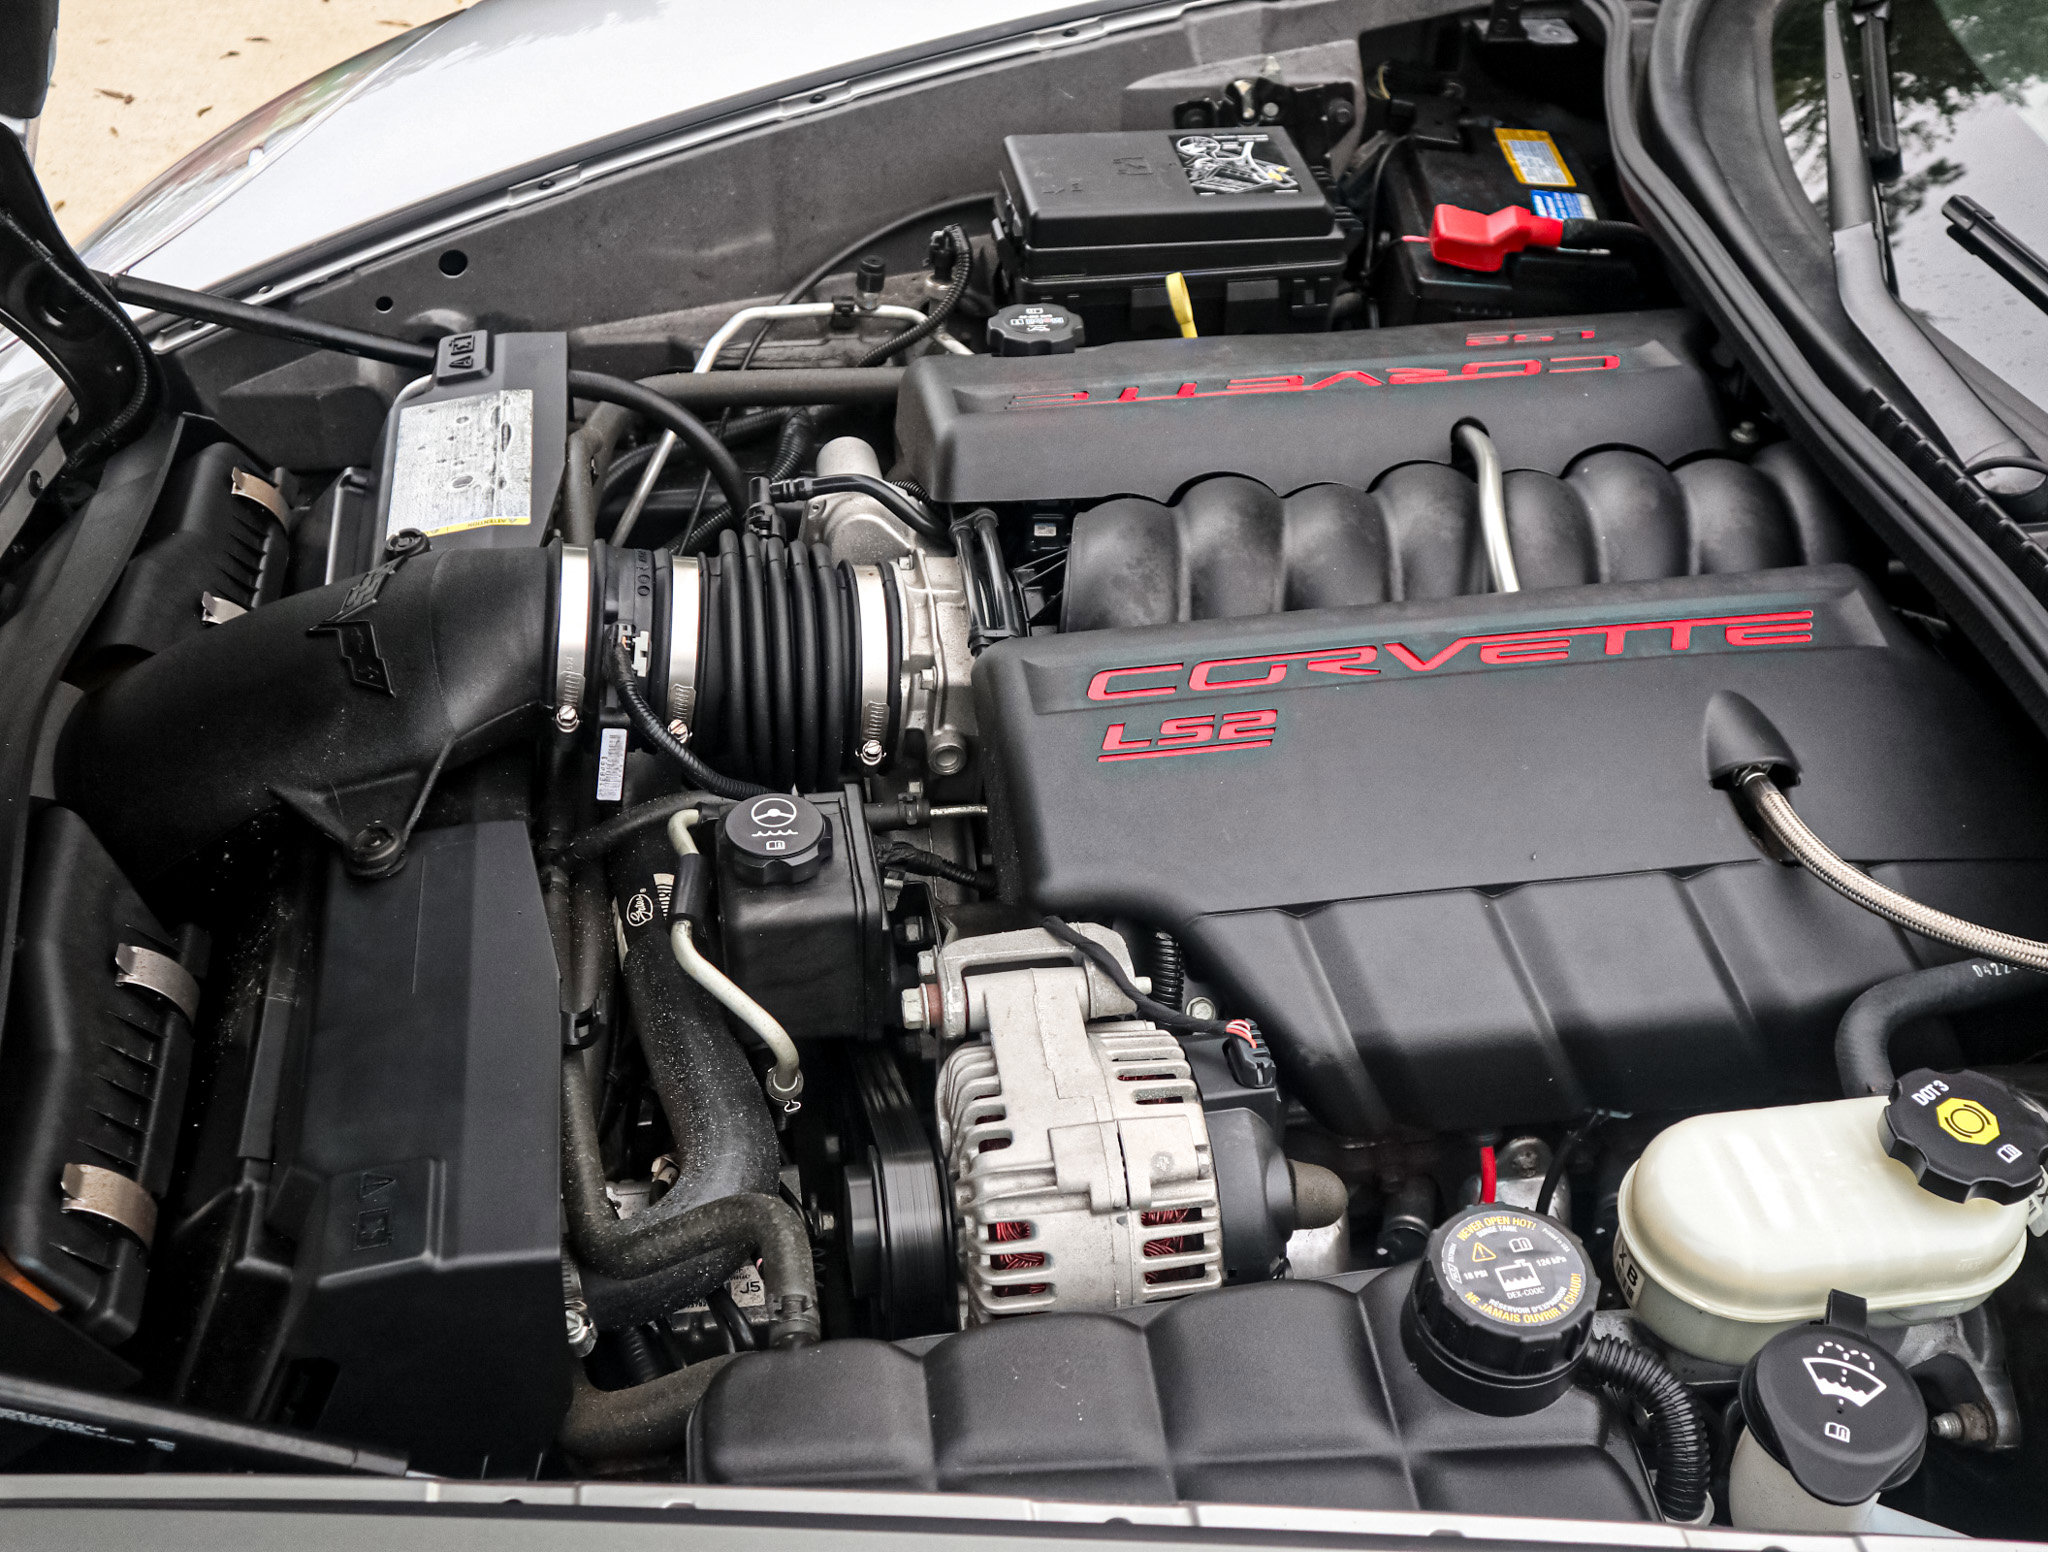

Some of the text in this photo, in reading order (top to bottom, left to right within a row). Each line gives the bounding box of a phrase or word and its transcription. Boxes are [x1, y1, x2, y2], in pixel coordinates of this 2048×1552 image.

[1004, 354, 1620, 410] CORVETTE
[1087, 610, 1813, 701] CORVETTE
[1100, 709, 1278, 752] LS2
[1911, 1079, 1950, 1106] DOT 3
[1456, 1216, 1537, 1242] NEVER OPEN HOT!
[1536, 1258, 1551, 1267] 124
[1626, 1264, 1638, 1287] B
[740, 1281, 761, 1294] J5
[1463, 1271, 1473, 1281] 18
[1465, 1291, 1481, 1306] NE
[1479, 1301, 1521, 1323] JAMAIS
[1523, 1309, 1562, 1324] OUVRIR
